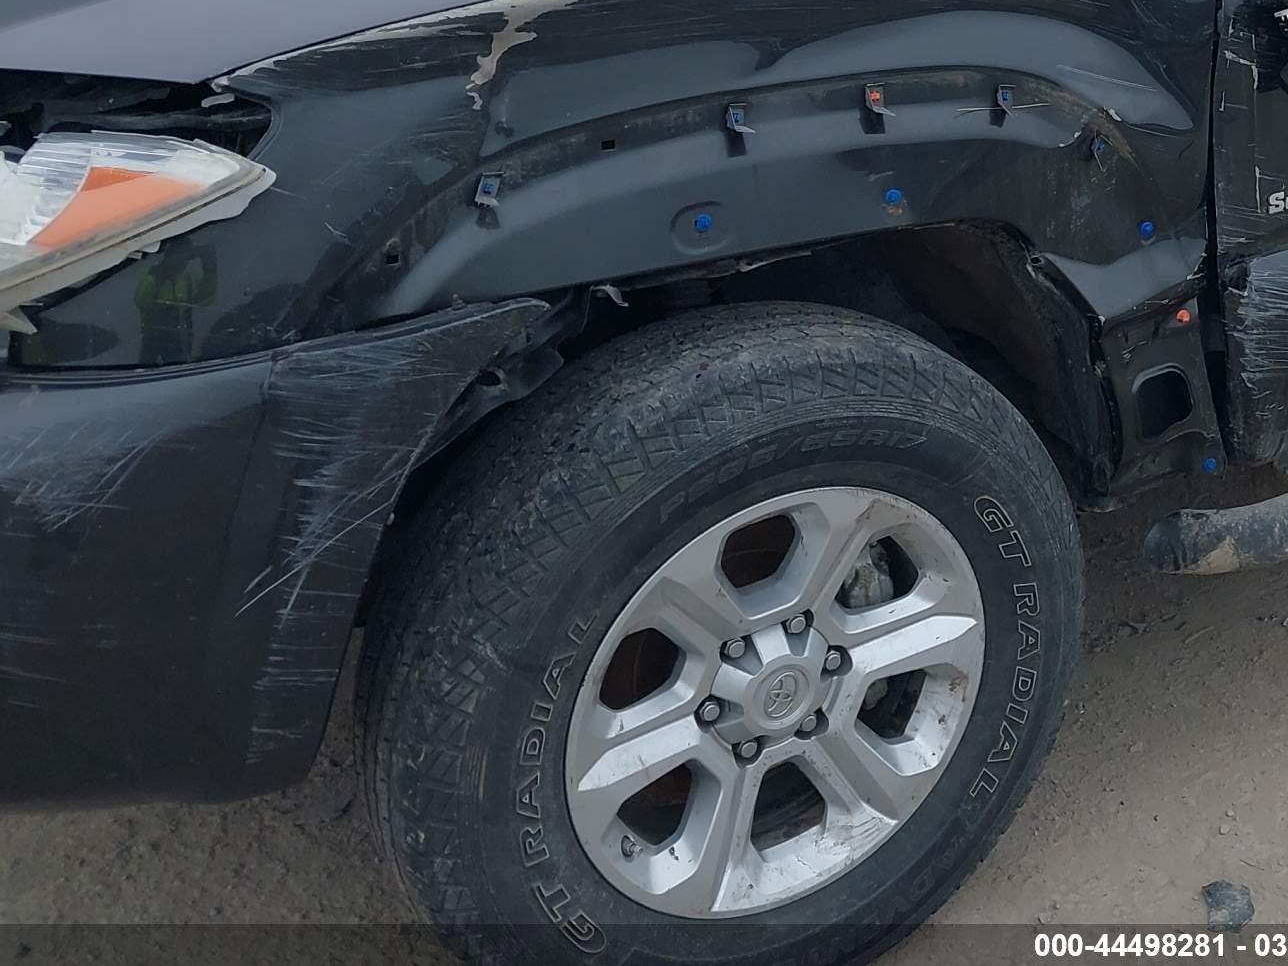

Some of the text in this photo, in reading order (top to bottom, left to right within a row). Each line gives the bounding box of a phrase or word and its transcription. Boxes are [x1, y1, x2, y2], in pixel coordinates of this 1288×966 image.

[515, 612, 607, 954] GT RADIAL
[969, 495, 1041, 797] GT RADIAL
